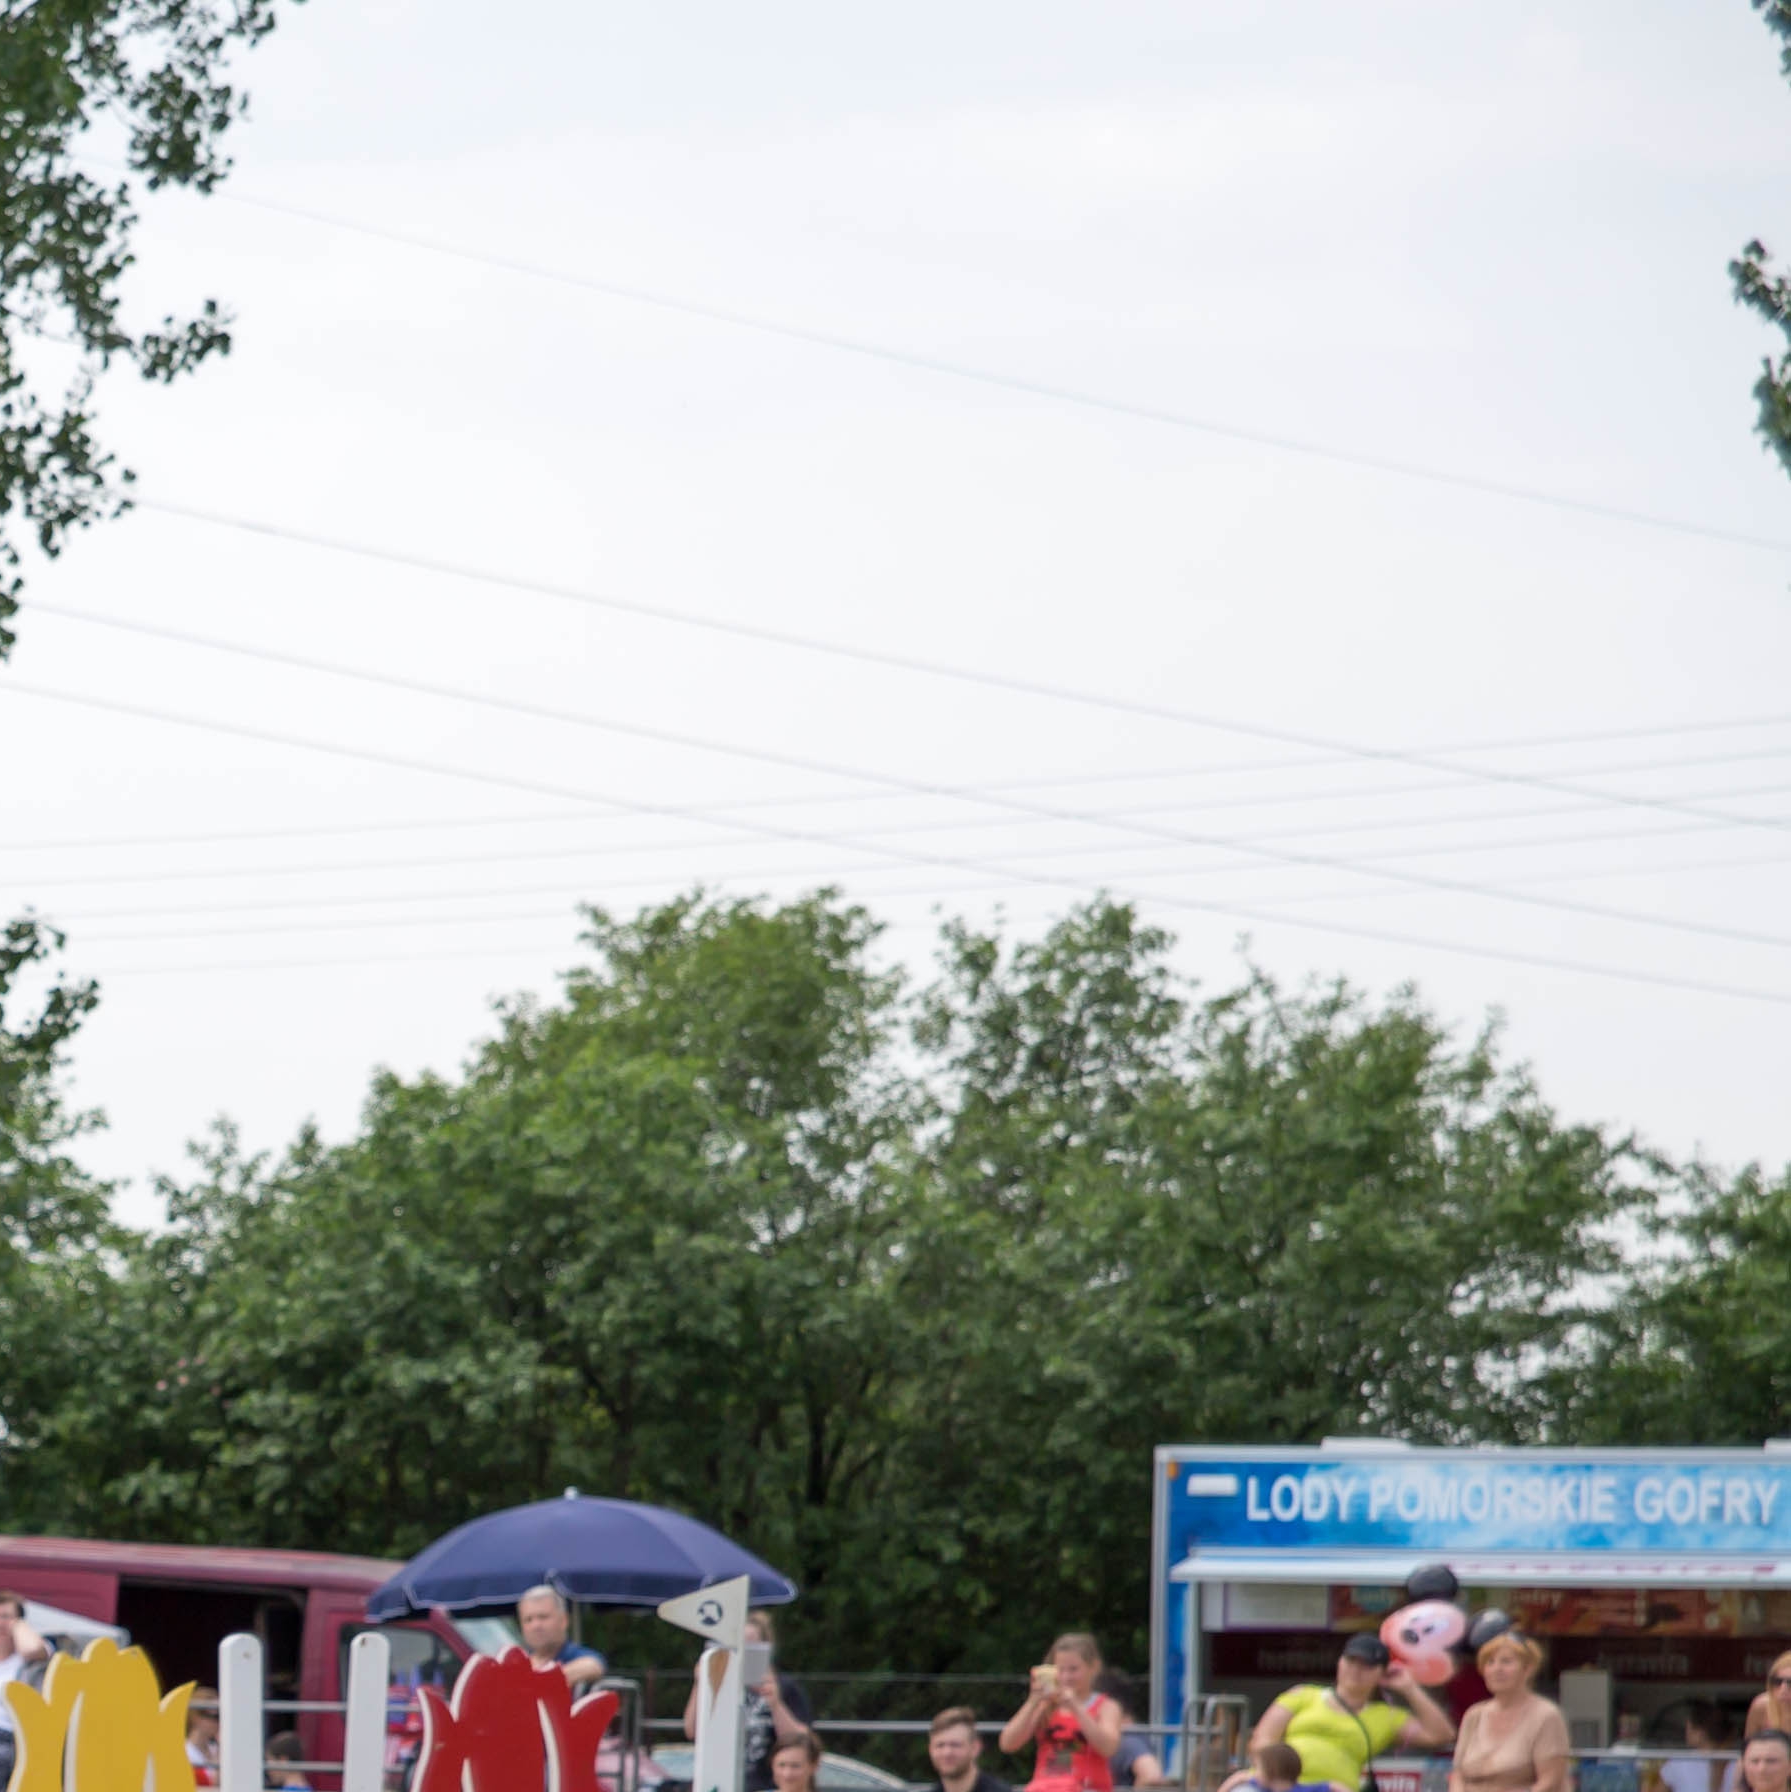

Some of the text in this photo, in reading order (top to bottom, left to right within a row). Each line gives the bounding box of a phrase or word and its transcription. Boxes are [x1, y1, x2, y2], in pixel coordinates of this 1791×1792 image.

[1246, 1475, 1781, 1526] LODY POMORSKIE GOFRY
